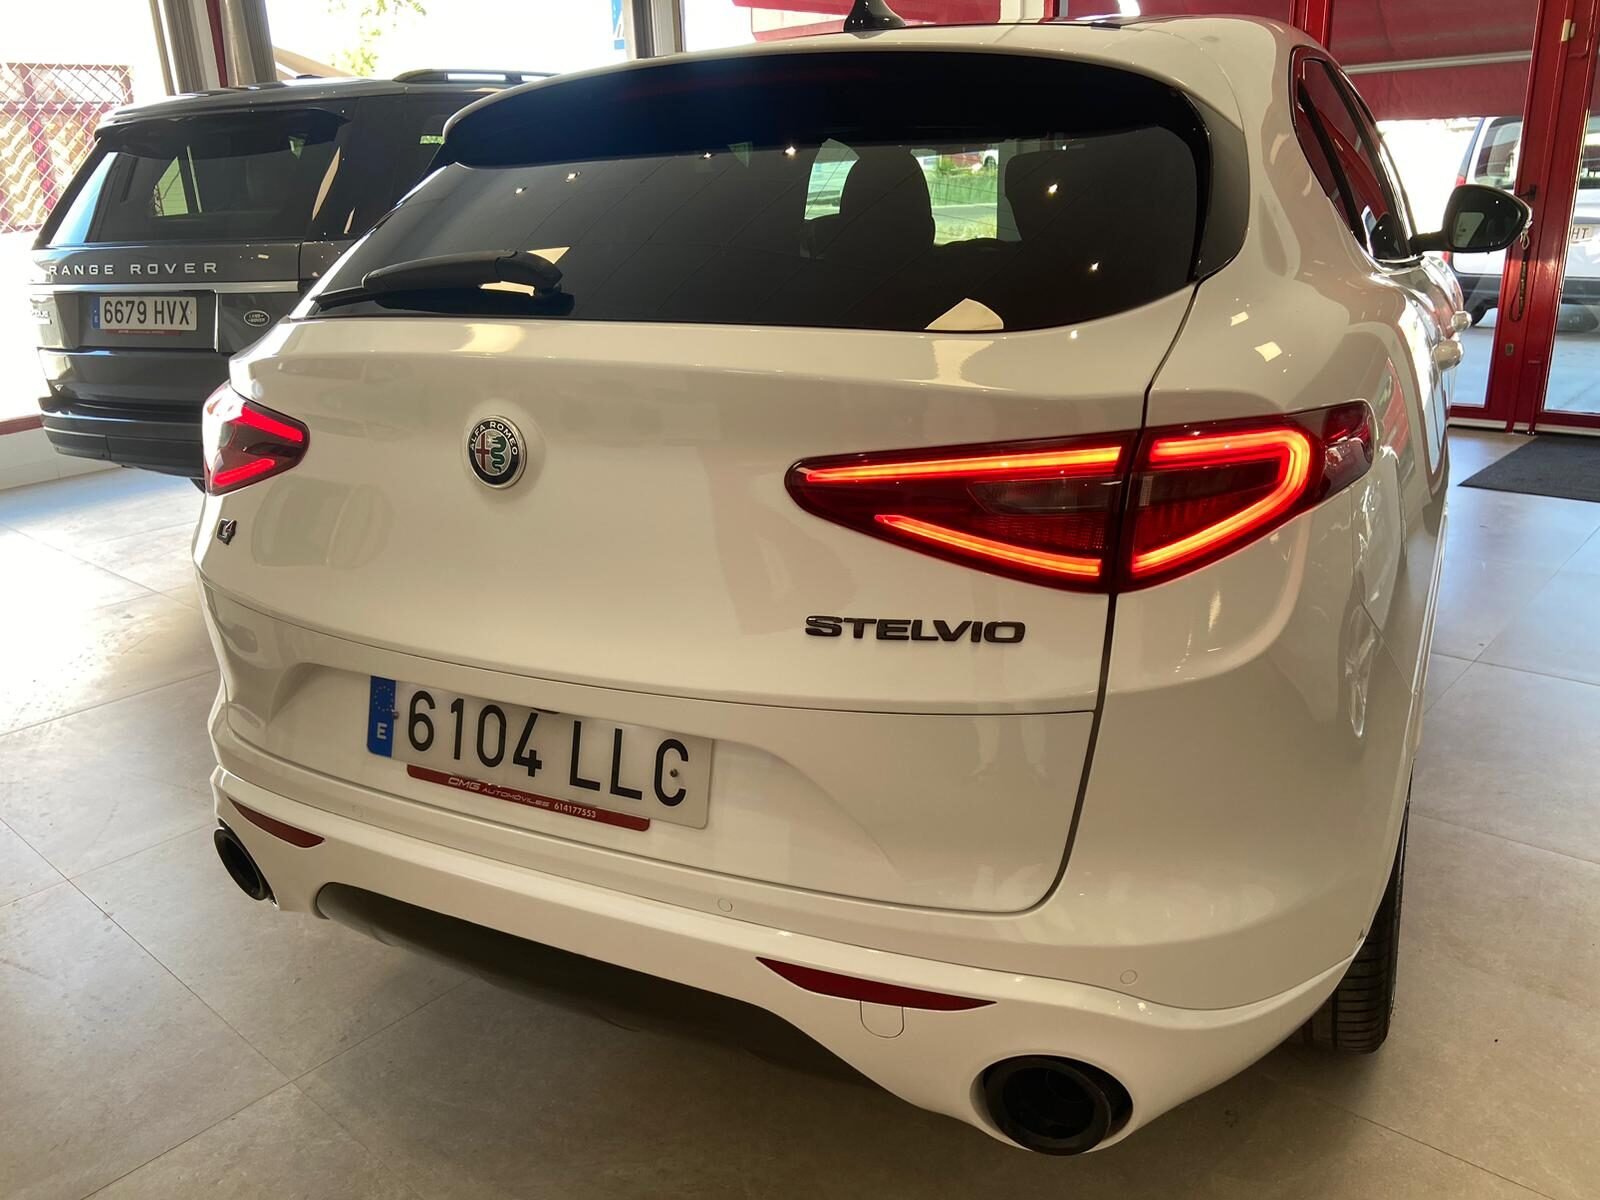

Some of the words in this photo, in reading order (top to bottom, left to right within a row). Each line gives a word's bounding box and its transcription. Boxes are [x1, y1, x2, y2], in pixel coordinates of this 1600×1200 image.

[48, 264, 114, 275] RANGE
[130, 262, 217, 275] ROVER
[104, 300, 147, 324] 6679
[154, 300, 190, 325] HVX
[470, 424, 486, 451] ALFA
[489, 421, 518, 455] ROMEO
[805, 615, 1026, 643] STELVIO
[376, 722, 388, 740] E
[408, 690, 543, 777] 6104
[569, 720, 689, 807] LLC
[447, 777, 481, 791] CMG
[554, 802, 597, 818] 614177553
